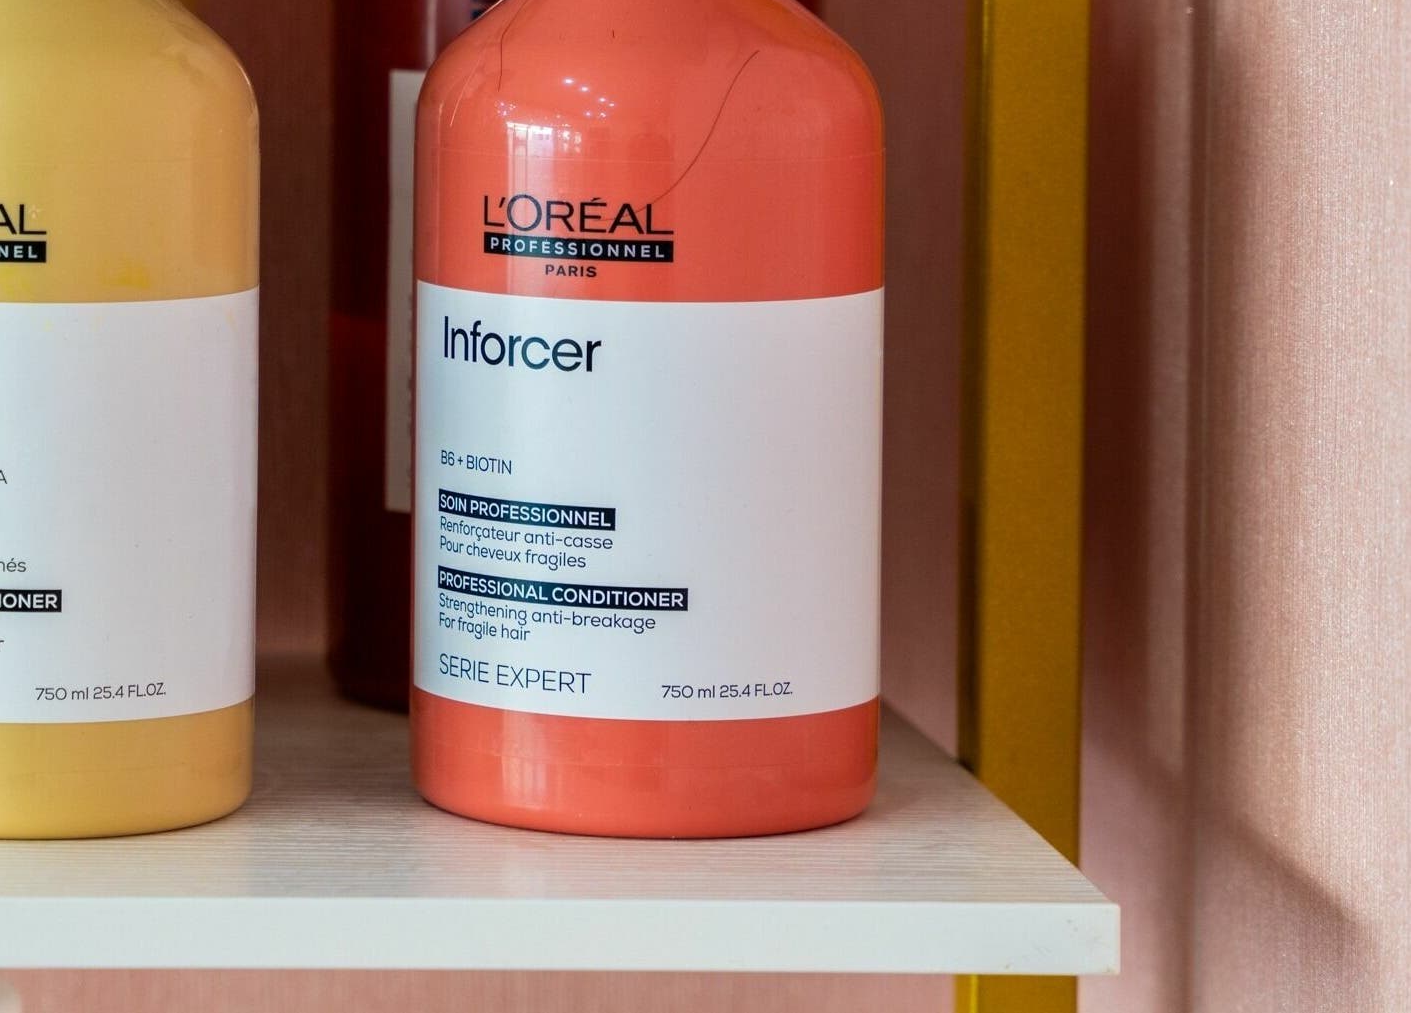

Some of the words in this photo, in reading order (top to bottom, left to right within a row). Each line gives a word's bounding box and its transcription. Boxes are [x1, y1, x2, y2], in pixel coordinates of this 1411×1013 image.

[484, 194, 674, 235] L'ORÉAL
[490, 237, 665, 259] PROFESSIONNEL
[545, 264, 597, 278] PARIS
[444, 316, 602, 372] Inforcer
[441, 449, 455, 466] B6
[466, 455, 512, 475] BIOTIN
[440, 494, 467, 513] SOIN
[470, 500, 611, 527] PROFESSIONNEL
[440, 516, 519, 543] Renforçateur
[524, 531, 613, 550] anti-casse
[440, 536, 463, 554] Pour
[466, 542, 521, 563] cheveux
[525, 549, 586, 571] fragiles
[439, 571, 548, 602] PROFESSIONAL
[552, 587, 684, 608] CONDITIONER
[439, 593, 528, 626] Strengthening
[531, 608, 656, 634] anti-breakage
[439, 613, 455, 629] For
[458, 616, 497, 640] fragile
[501, 625, 530, 641] hair
[439, 654, 489, 684] SERIE
[497, 664, 592, 694] EXPERT
[35, 688, 67, 700] 750
[72, 687, 88, 700] ml
[93, 686, 124, 699] 25.4
[662, 685, 693, 698] 750
[698, 686, 715, 698] ml
[720, 684, 750, 698] 25.4
